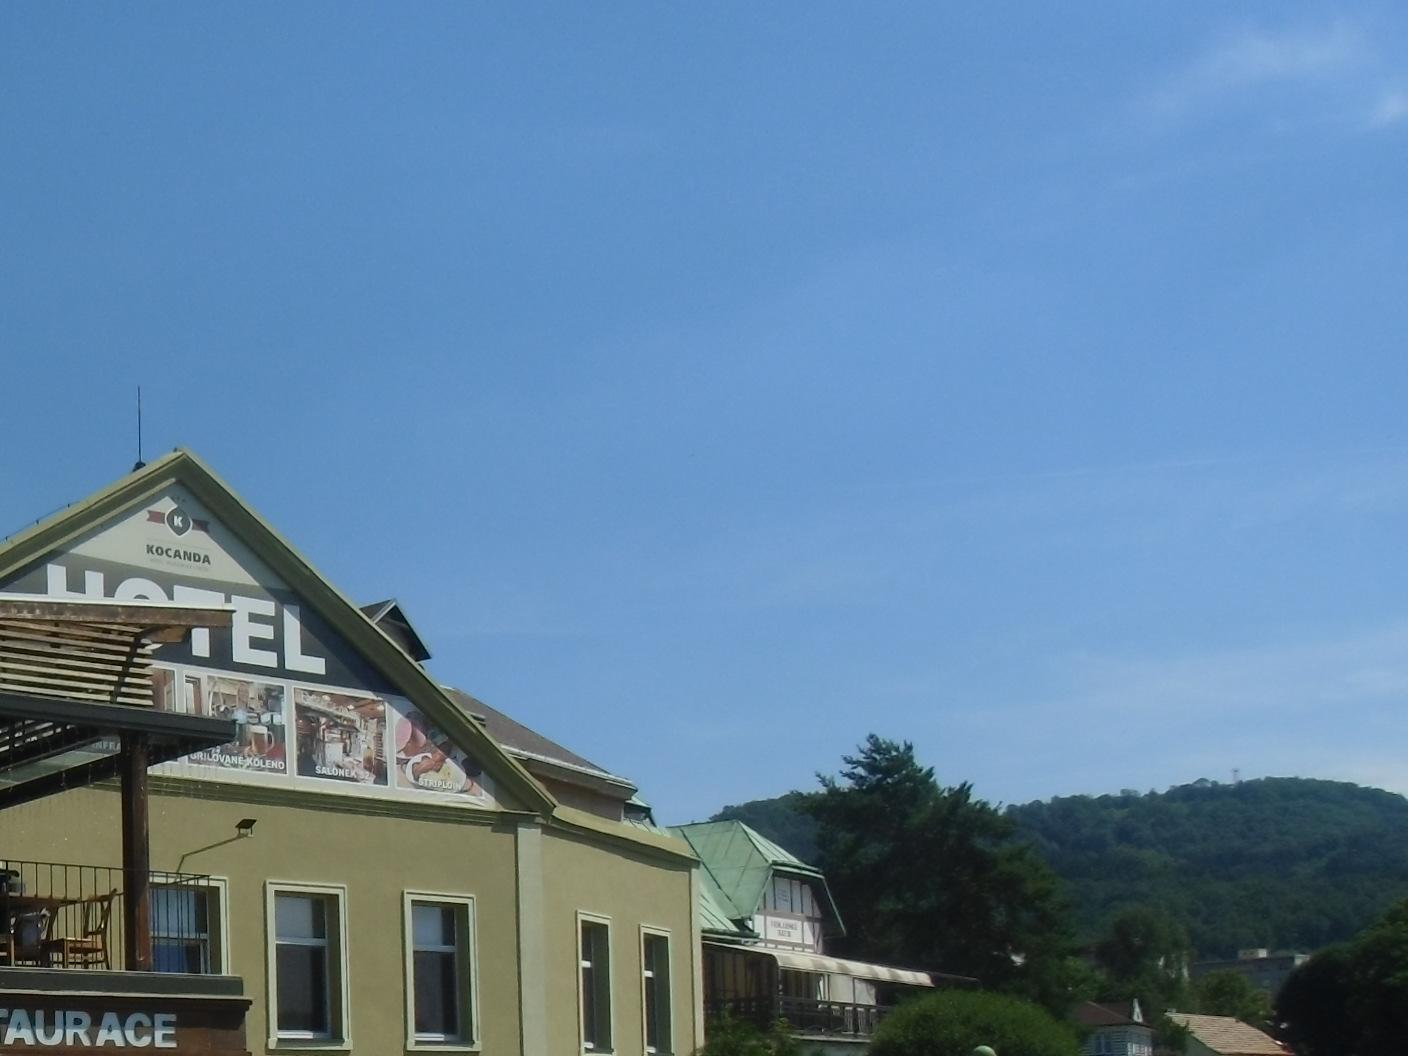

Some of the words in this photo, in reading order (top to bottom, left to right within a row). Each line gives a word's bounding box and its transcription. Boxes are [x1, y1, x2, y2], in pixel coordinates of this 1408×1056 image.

[173, 515, 183, 528] K
[146, 544, 211, 566] KOCANDA
[247, 757, 285, 770] KOLENO
[314, 765, 357, 779] SALONEK
